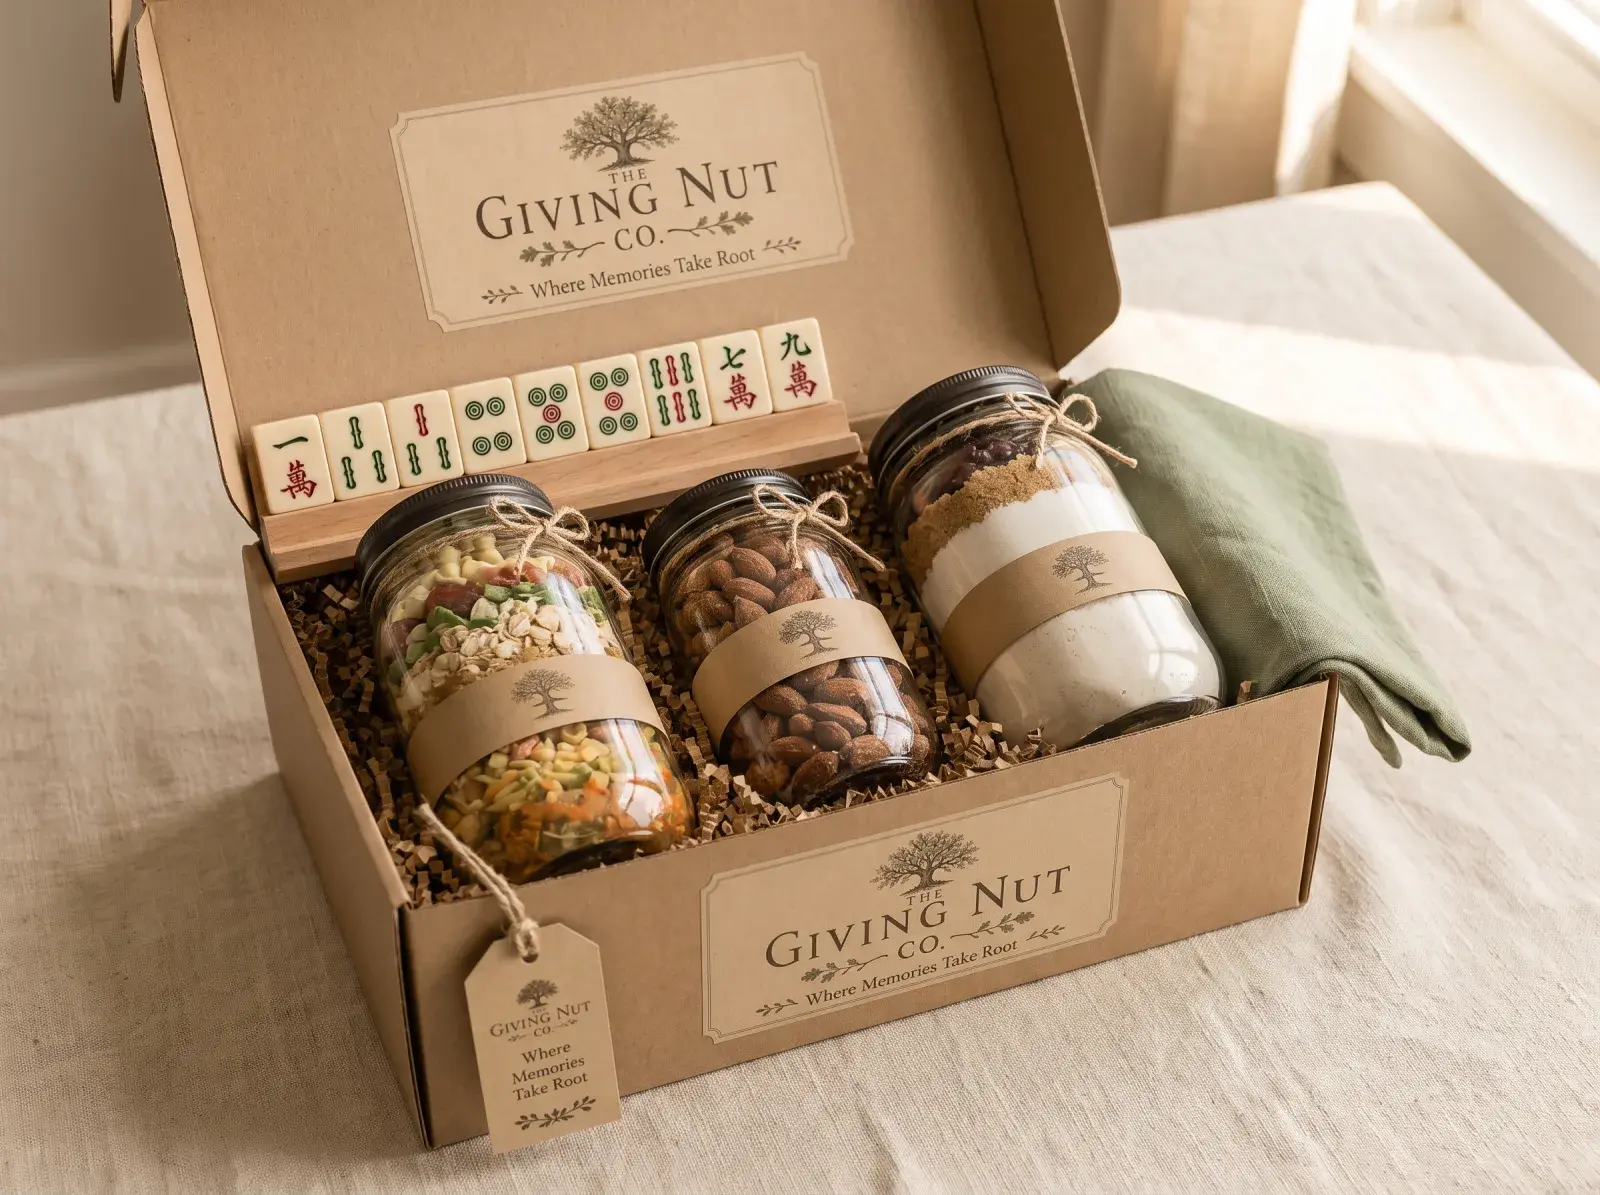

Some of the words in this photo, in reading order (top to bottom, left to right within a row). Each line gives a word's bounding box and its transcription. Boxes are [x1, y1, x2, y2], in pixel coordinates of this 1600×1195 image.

[608, 168, 647, 184] THE
[475, 182, 658, 240] GIVING
[676, 161, 778, 208] NUT
[614, 224, 664, 252] CO.
[530, 279, 586, 299] Where
[589, 262, 671, 290] Memories
[673, 254, 713, 274] Take
[717, 247, 756, 267] Root
[905, 889, 943, 906] THE
[765, 900, 946, 968] GIVING
[972, 865, 1071, 916] NUT
[897, 935, 944, 960] CO.
[805, 985, 856, 1006] Where
[861, 963, 937, 991] Memories
[942, 951, 977, 969] Take
[982, 940, 1018, 959] Root
[490, 1012, 550, 1037] GIVING
[557, 1001, 591, 1020] NUT
[534, 1026, 554, 1037] CO.
[521, 1044, 571, 1064] Where
[512, 1057, 585, 1085] Memories
[513, 1085, 548, 1101] Take
[553, 1072, 588, 1091] Root
